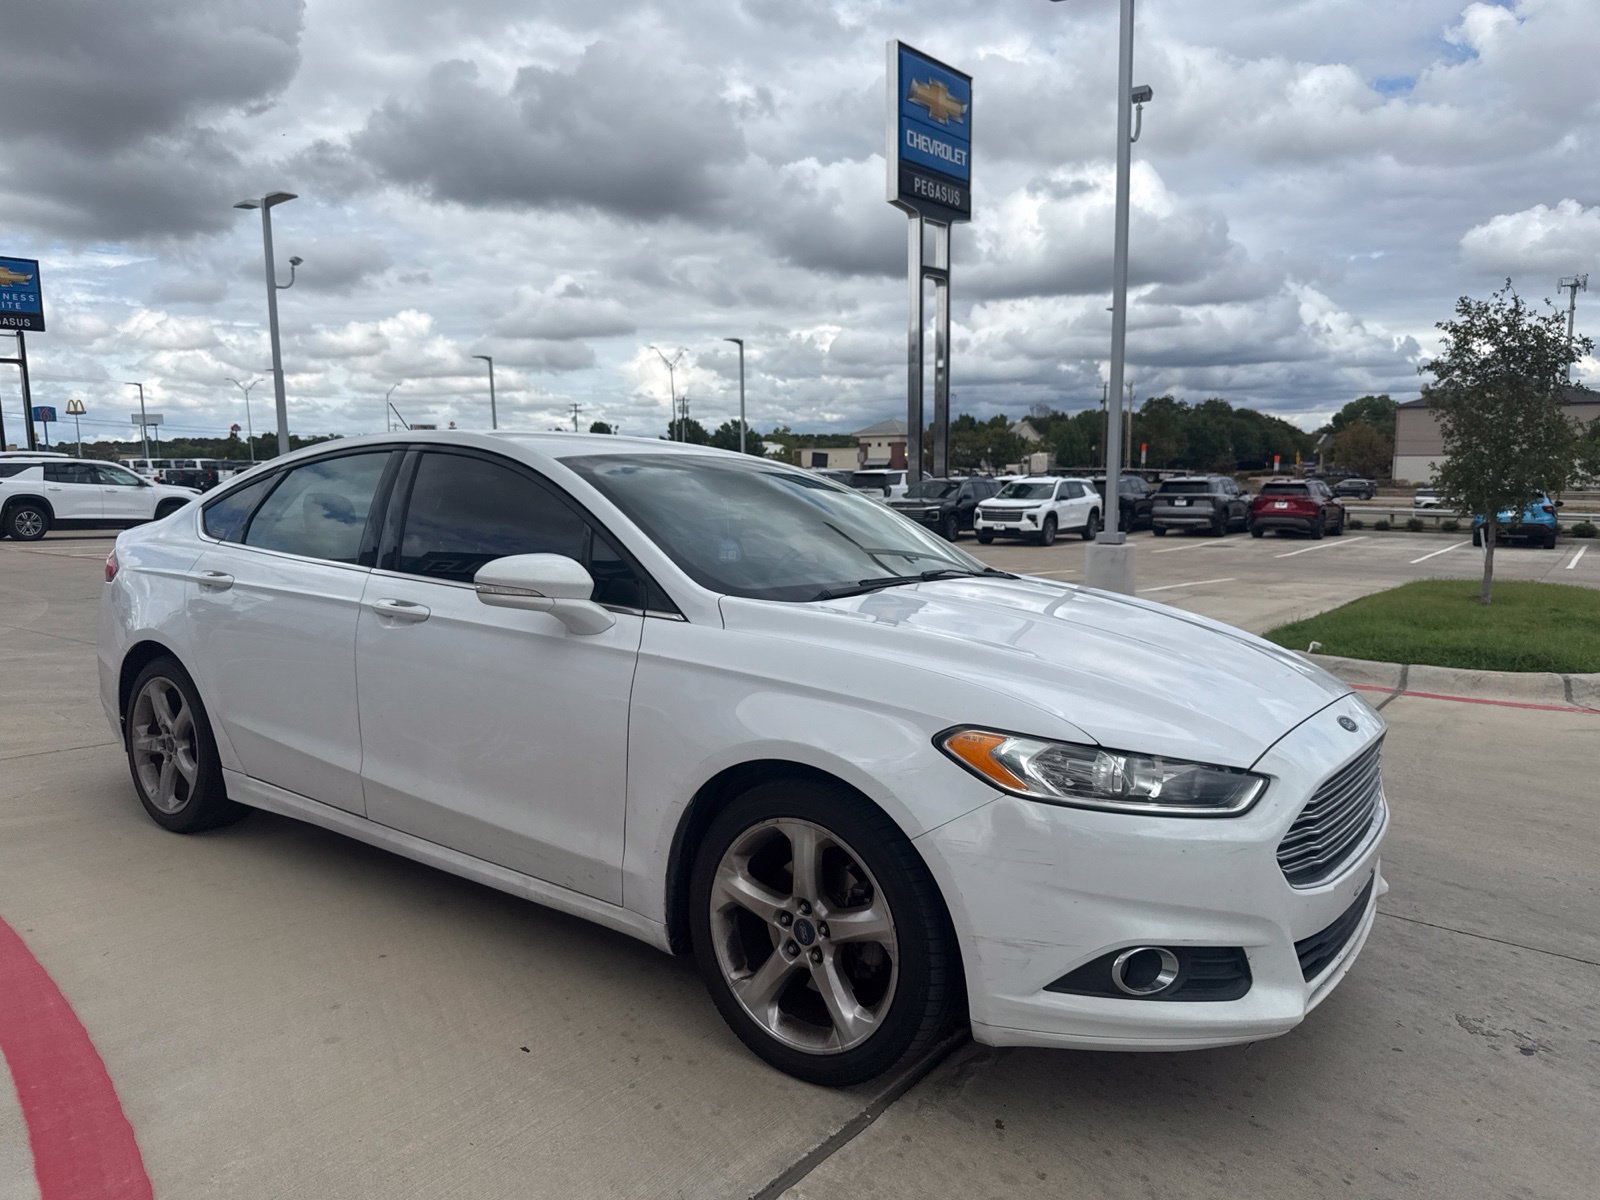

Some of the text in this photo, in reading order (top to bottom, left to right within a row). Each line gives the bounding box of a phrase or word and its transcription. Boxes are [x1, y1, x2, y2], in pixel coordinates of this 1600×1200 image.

[906, 129, 967, 166] CHEVROLET
[914, 177, 961, 206] PEGASUS
[0, 317, 31, 327] ASUS
